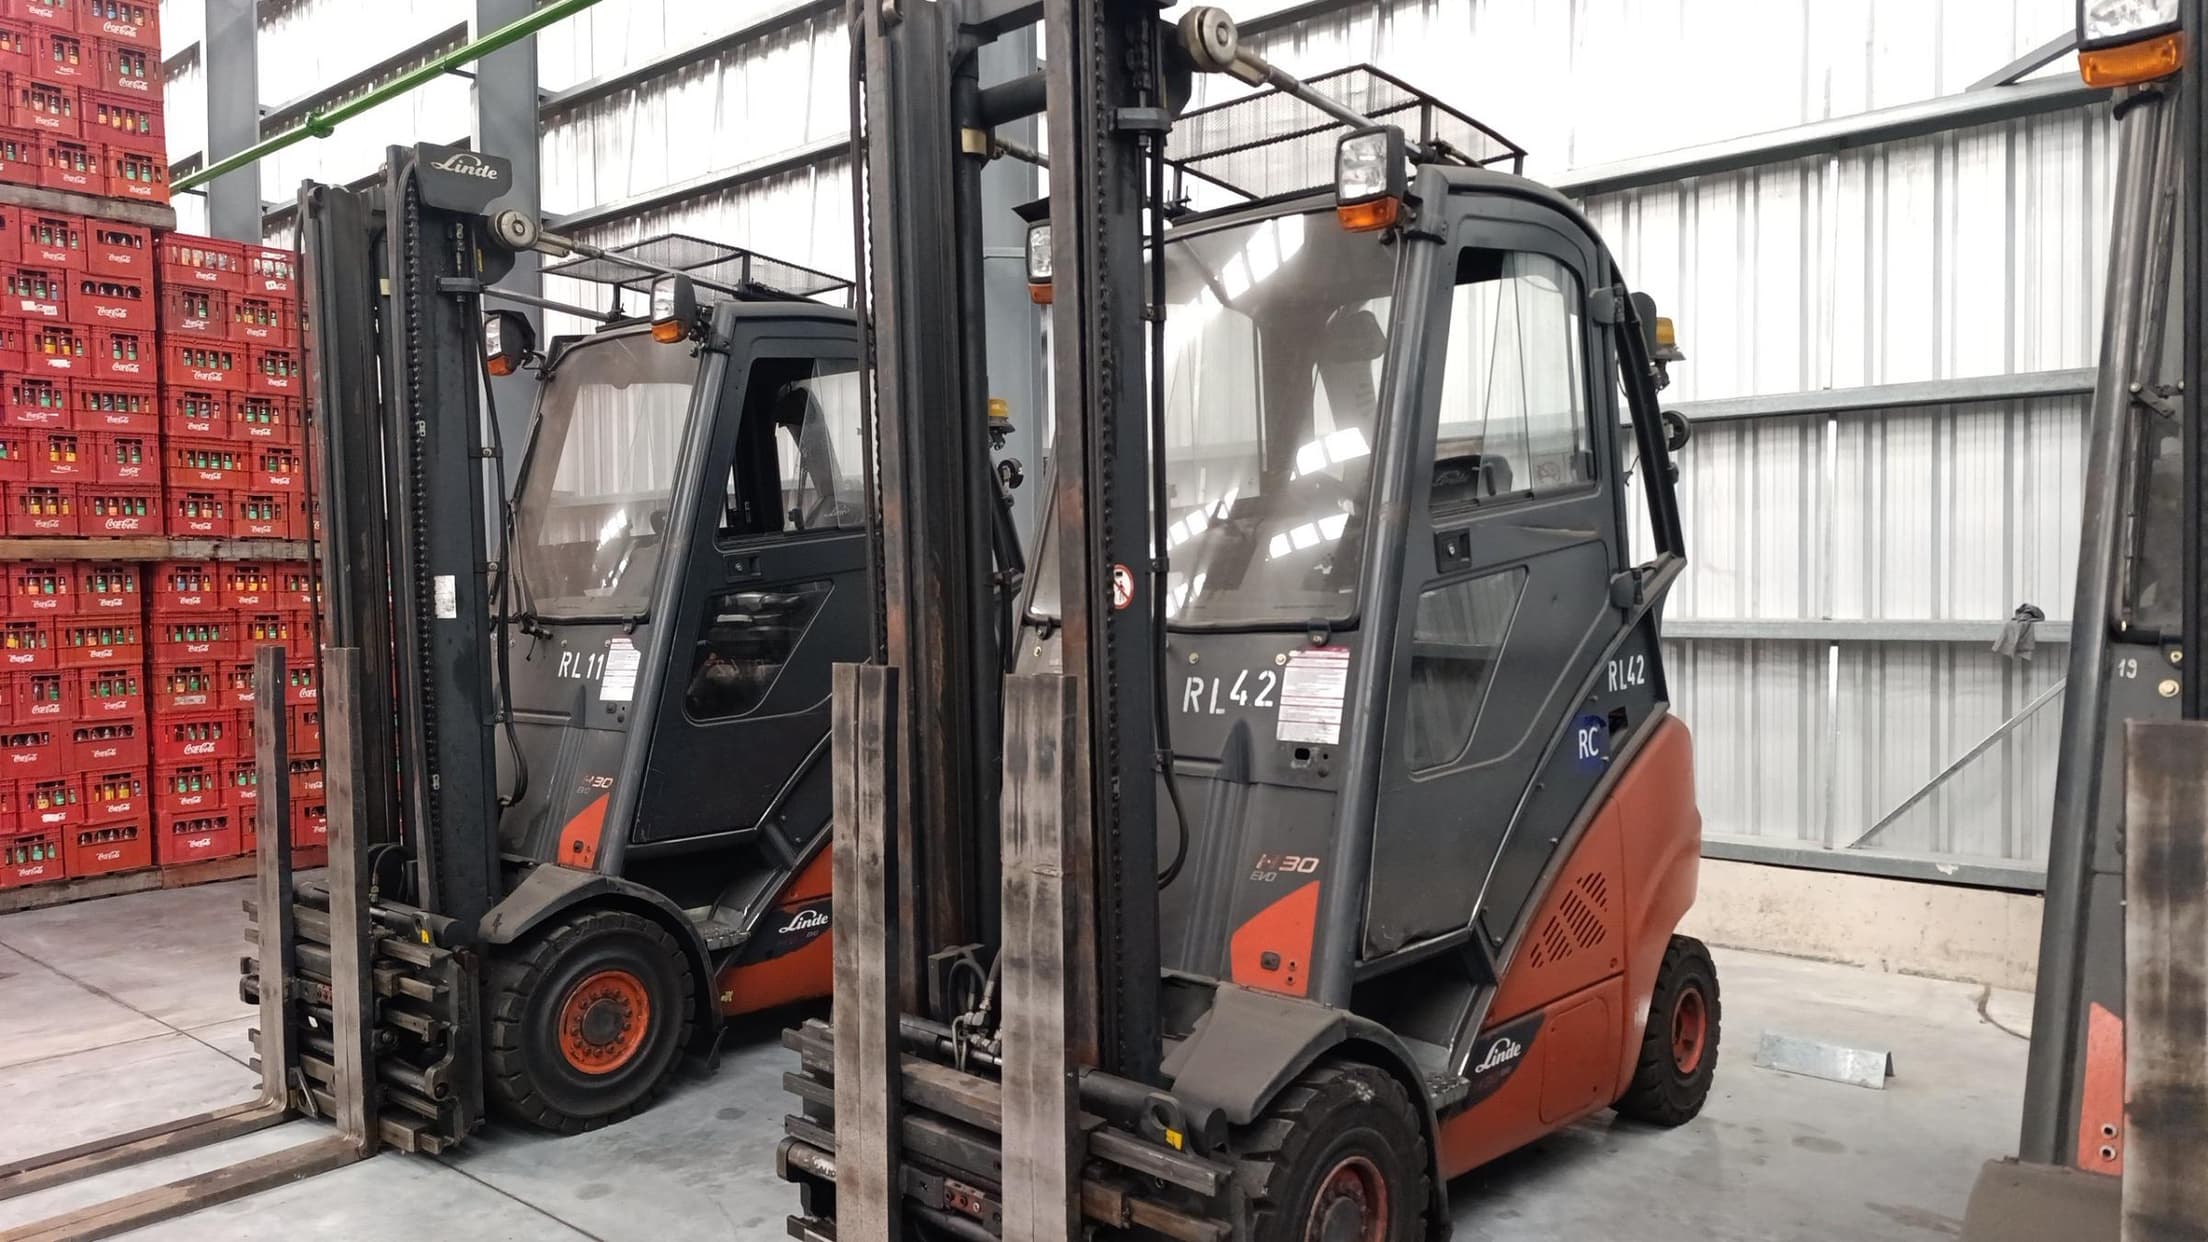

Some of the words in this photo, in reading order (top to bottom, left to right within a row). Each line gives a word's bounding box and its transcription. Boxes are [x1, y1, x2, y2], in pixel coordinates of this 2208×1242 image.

[430, 153, 498, 180] Linde
[1608, 654, 1646, 692] RL42
[2118, 658, 2138, 679] 19
[1579, 727, 1599, 760] RC
[779, 910, 829, 934] Linde
[1474, 1037, 1521, 1073] Linde
